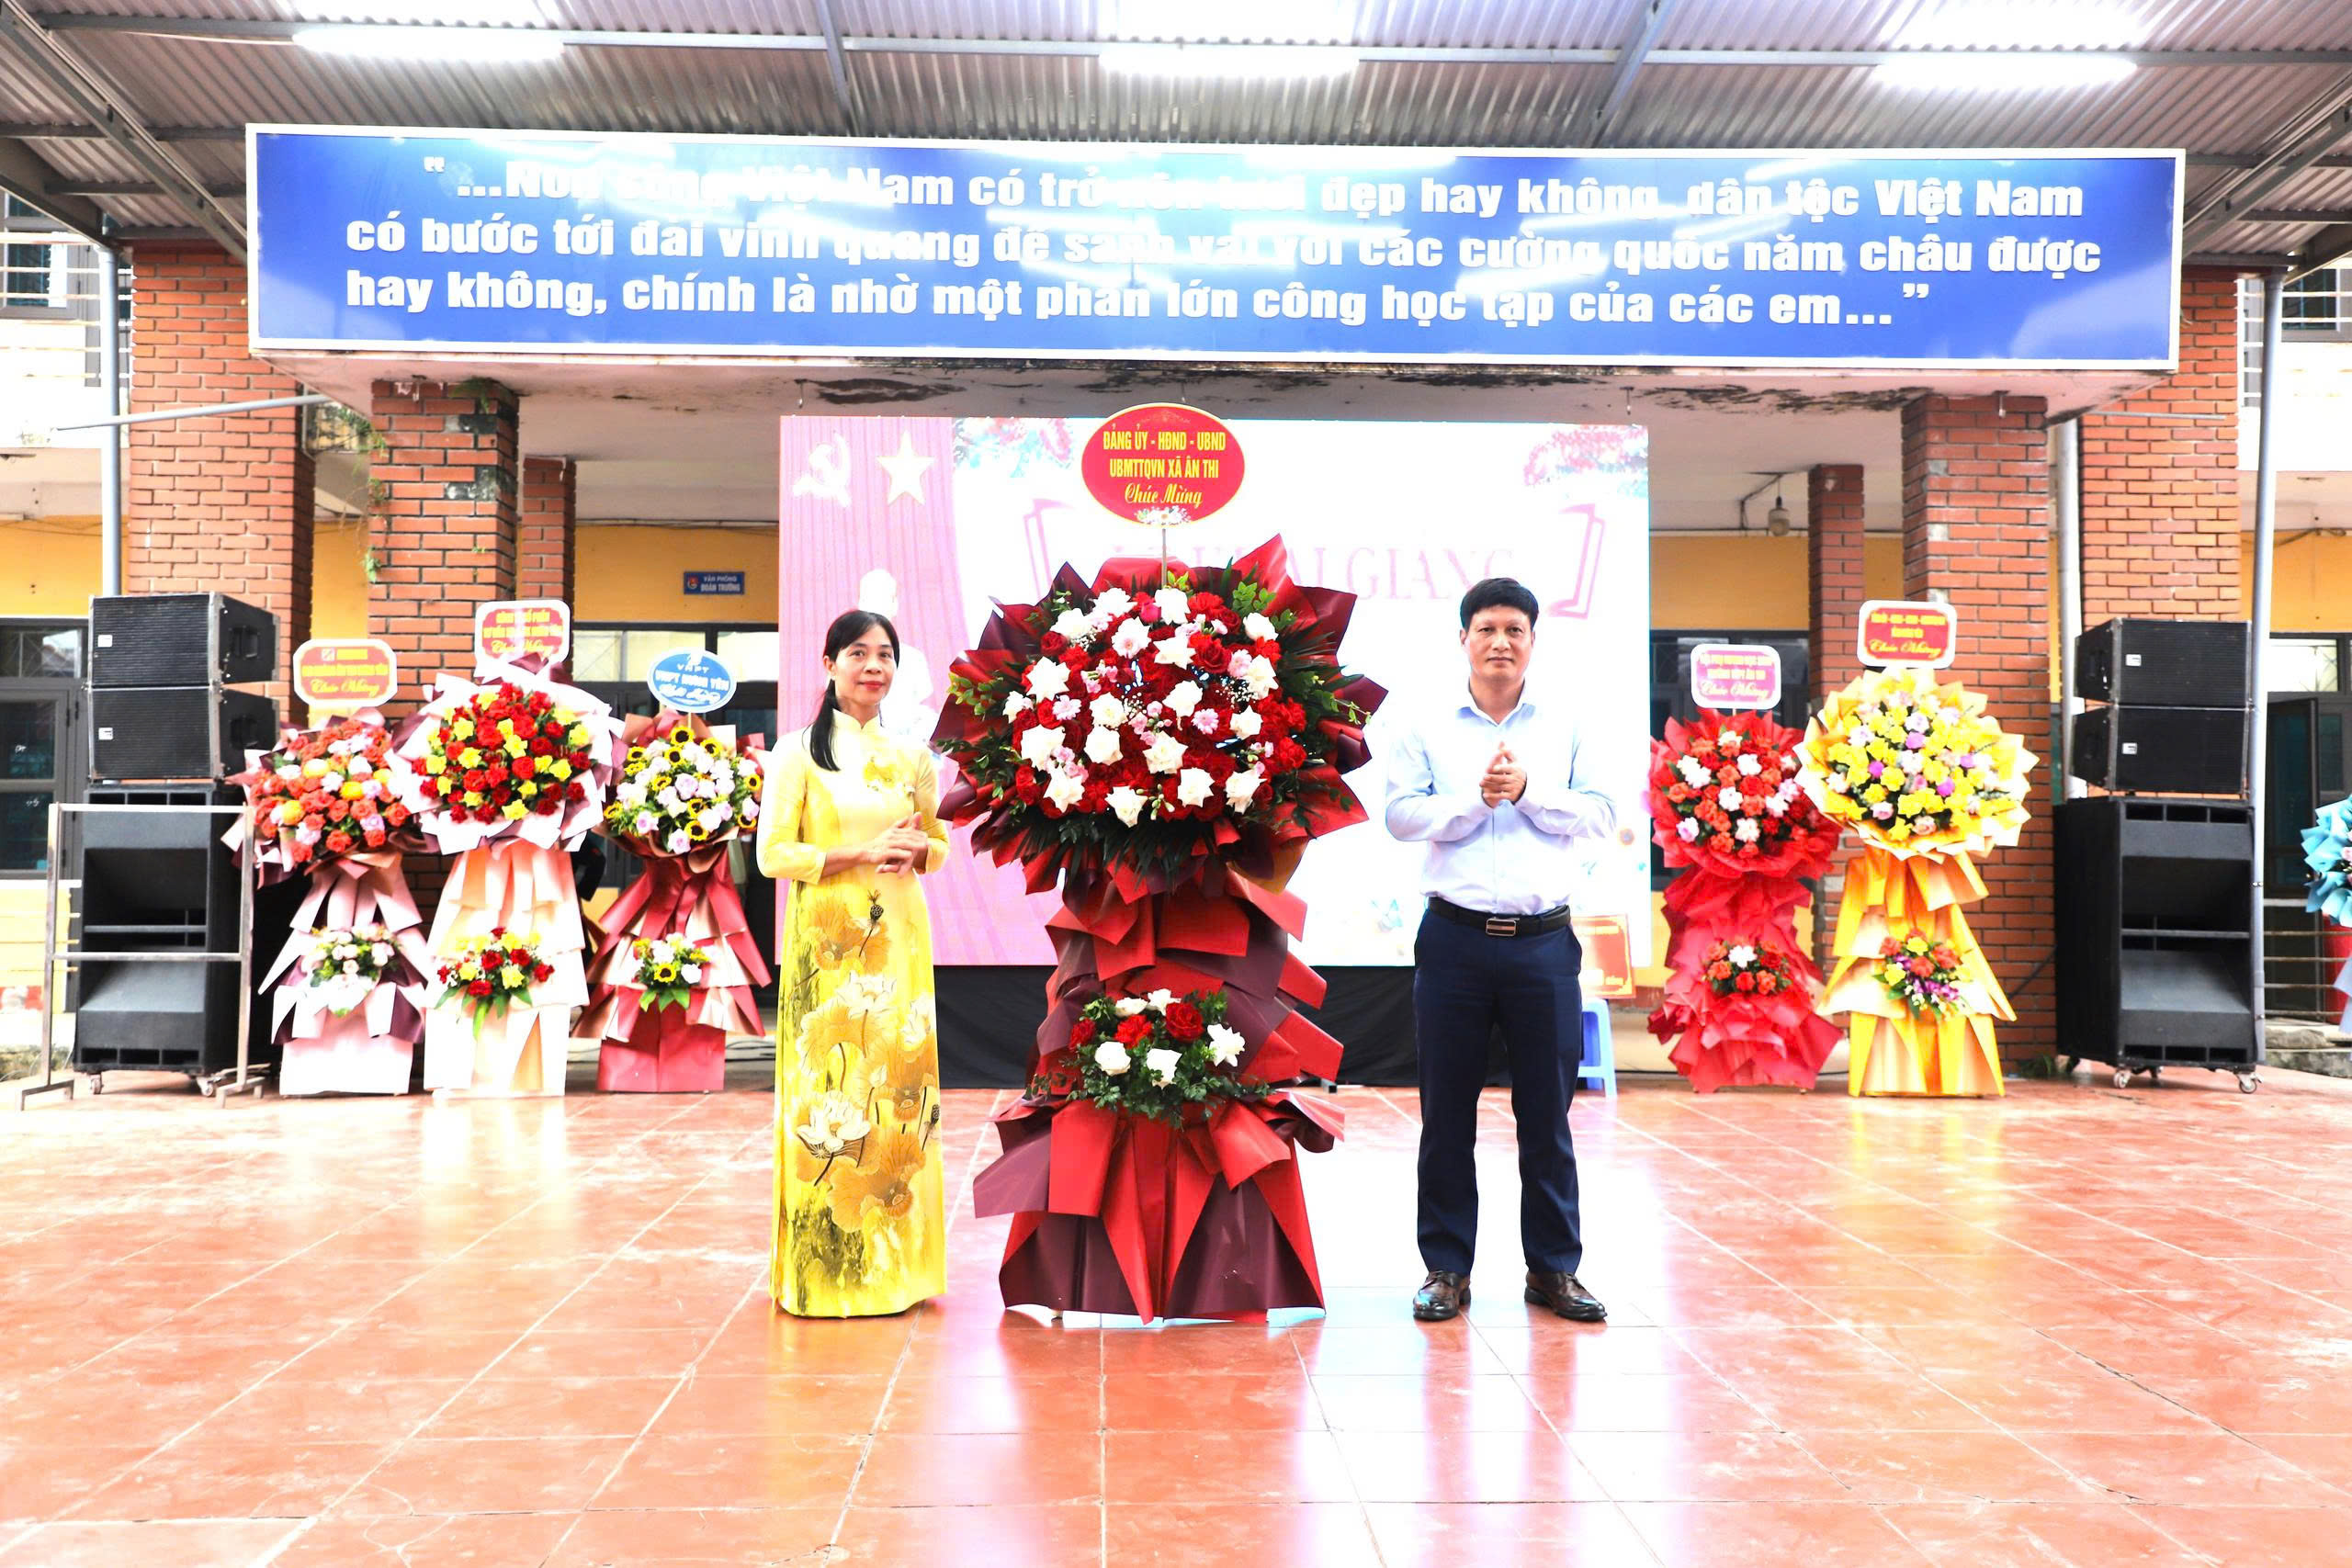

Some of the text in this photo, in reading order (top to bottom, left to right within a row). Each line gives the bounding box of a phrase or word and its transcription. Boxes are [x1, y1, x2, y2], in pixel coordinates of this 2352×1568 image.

[847, 168, 953, 206] Nam
[968, 169, 1024, 207] có
[1039, 164, 1107, 208] trở
[1321, 176, 1405, 219] đẹp
[1420, 177, 1503, 219] hay
[1687, 177, 1777, 217] dân
[1786, 179, 1860, 223] tộc
[1876, 178, 1962, 223] Việt
[1976, 180, 2083, 218] Nam
[346, 210, 405, 252] có
[421, 212, 538, 254] bước
[553, 213, 615, 255] tới
[718, 221, 820, 259] vinh
[834, 230, 979, 267] quang
[1358, 231, 1443, 267] các
[1459, 231, 1600, 276] cường
[1745, 235, 1842, 272] năm
[1860, 235, 1972, 273] châu
[1987, 235, 2101, 280] được
[346, 269, 434, 313] hay
[447, 270, 607, 317] không,
[623, 270, 755, 313] chính
[773, 273, 815, 314] là
[831, 274, 921, 314] nhờ
[933, 279, 1022, 321] một
[1167, 279, 1238, 319] lớn
[1253, 281, 1366, 326] công
[1382, 286, 1466, 327] học
[1569, 280, 1653, 323] của
[1669, 285, 1754, 323] các
[1102, 423, 1132, 450] ĐẢNG
[1135, 423, 1148, 450] ỦY
[1158, 431, 1187, 450] HĐND
[1197, 432, 1227, 451] UBND
[1109, 456, 1219, 479] UBMTTQVN XÃ ÂN THI
[1125, 483, 1203, 508] Chúc Mừng
